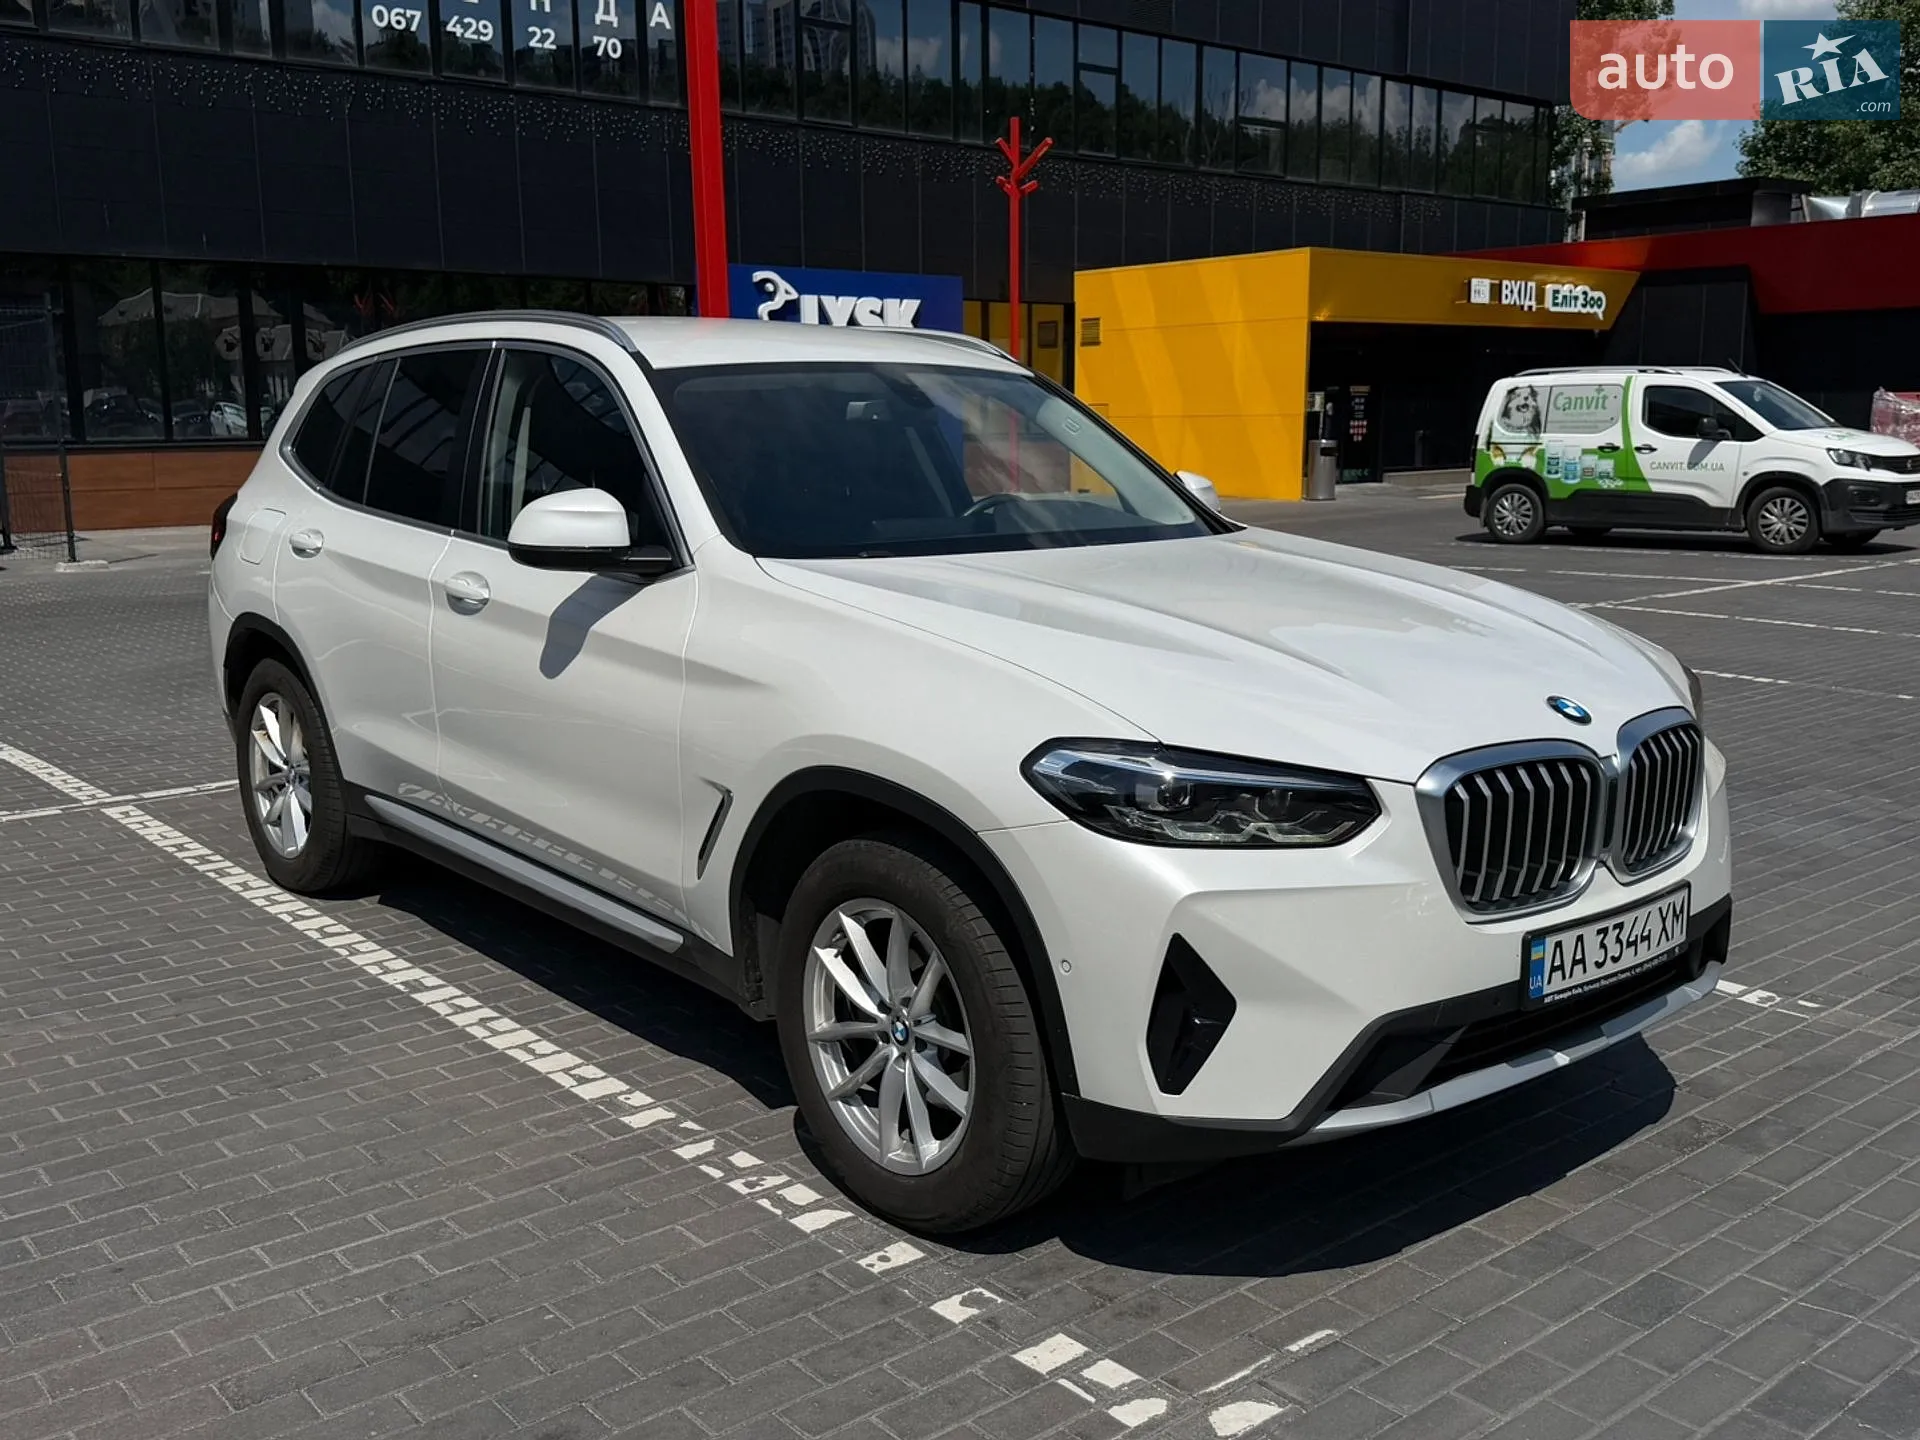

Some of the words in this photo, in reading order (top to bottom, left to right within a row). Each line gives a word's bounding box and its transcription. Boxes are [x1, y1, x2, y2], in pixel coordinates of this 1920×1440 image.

[371, 5, 422, 32] 067
[445, 15, 494, 42] 429
[527, 26, 557, 51] 22
[593, 36, 622, 60] 70
[1501, 279, 1536, 312] ВХІД
[1553, 386, 1609, 411] Canvit
[1649, 460, 1725, 472] CANVIT.COM.UA
[1546, 934, 1587, 986] AA
[1594, 910, 1652, 970] 3344
[1656, 895, 1686, 948] XM
[1529, 975, 1543, 990] UA
